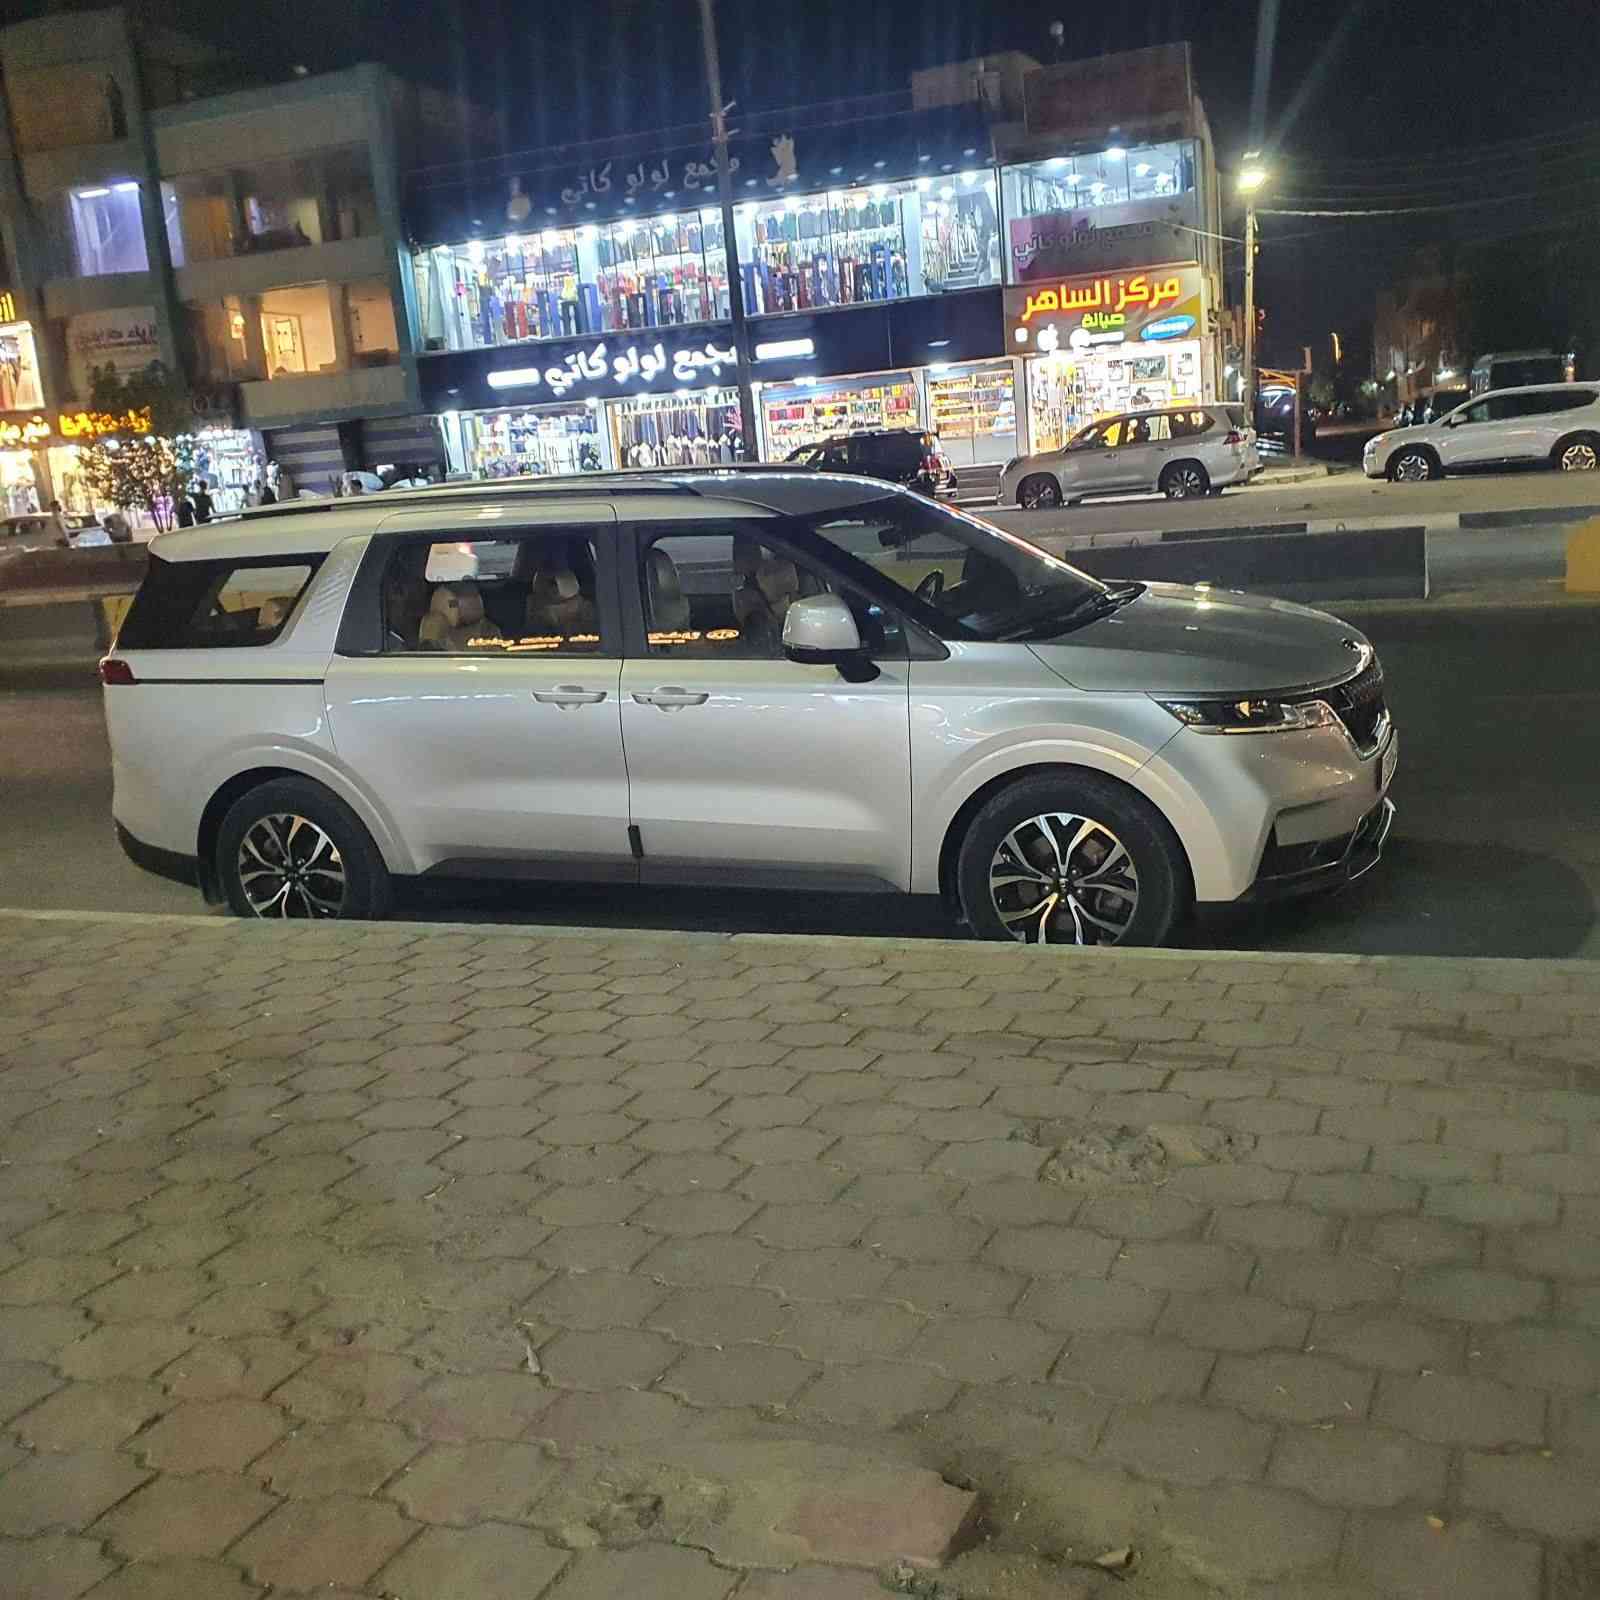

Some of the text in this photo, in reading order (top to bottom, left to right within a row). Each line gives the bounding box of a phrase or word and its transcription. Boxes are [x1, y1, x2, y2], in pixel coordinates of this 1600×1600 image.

[626, 159, 670, 194] لولو
[1021, 275, 1181, 321] مركز الساهر
[1081, 311, 1126, 329] صيانة
[544, 342, 608, 396] كاتي
[612, 343, 667, 384] لولو
